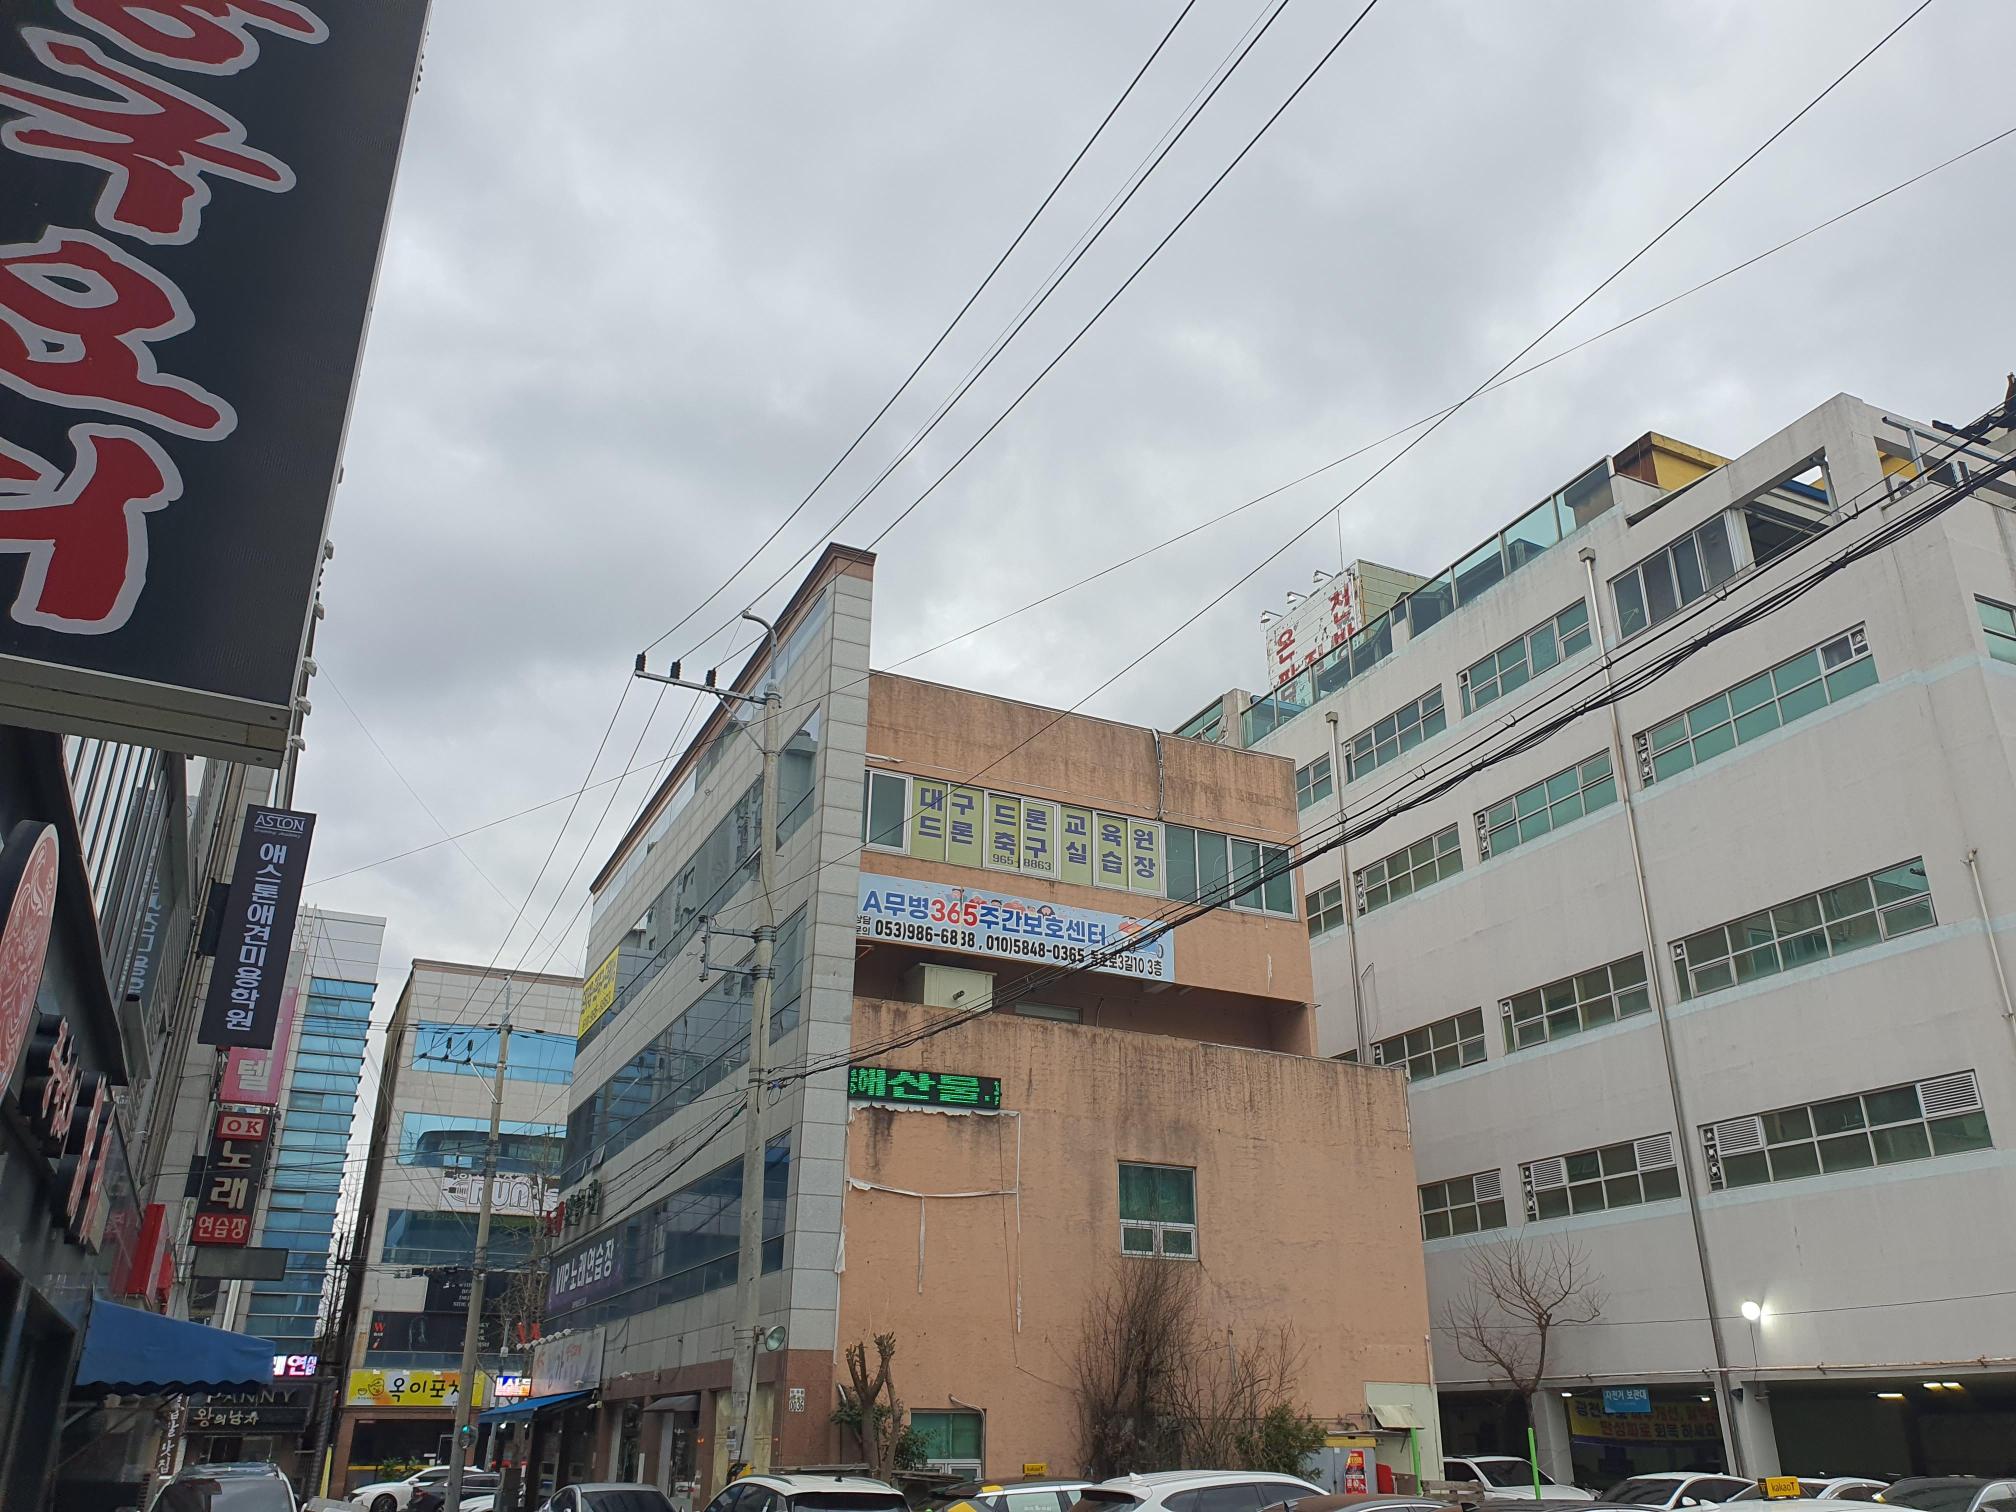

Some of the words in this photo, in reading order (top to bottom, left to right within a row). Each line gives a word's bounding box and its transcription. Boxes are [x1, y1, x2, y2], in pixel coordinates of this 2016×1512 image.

[255, 814, 305, 831] ASTON
[918, 816, 974, 845] 드론
[993, 831, 1048, 859] 축구
[1065, 841, 1156, 879] 실습장
[920, 787, 974, 816] 대구
[993, 804, 1048, 832] 드론
[1064, 814, 1154, 852] 교육원
[226, 843, 287, 1031] 애스톤애견미용학원
[986, 935, 1085, 963] 010)5848-0365
[1147, 959, 1163, 977] 3층
[227, 1120, 262, 1134] OK
[210, 1140, 251, 1209] 노래
[198, 1216, 247, 1239] 연습장
[555, 1262, 570, 1295] VIP
[569, 1238, 615, 1291] 노래연습장
